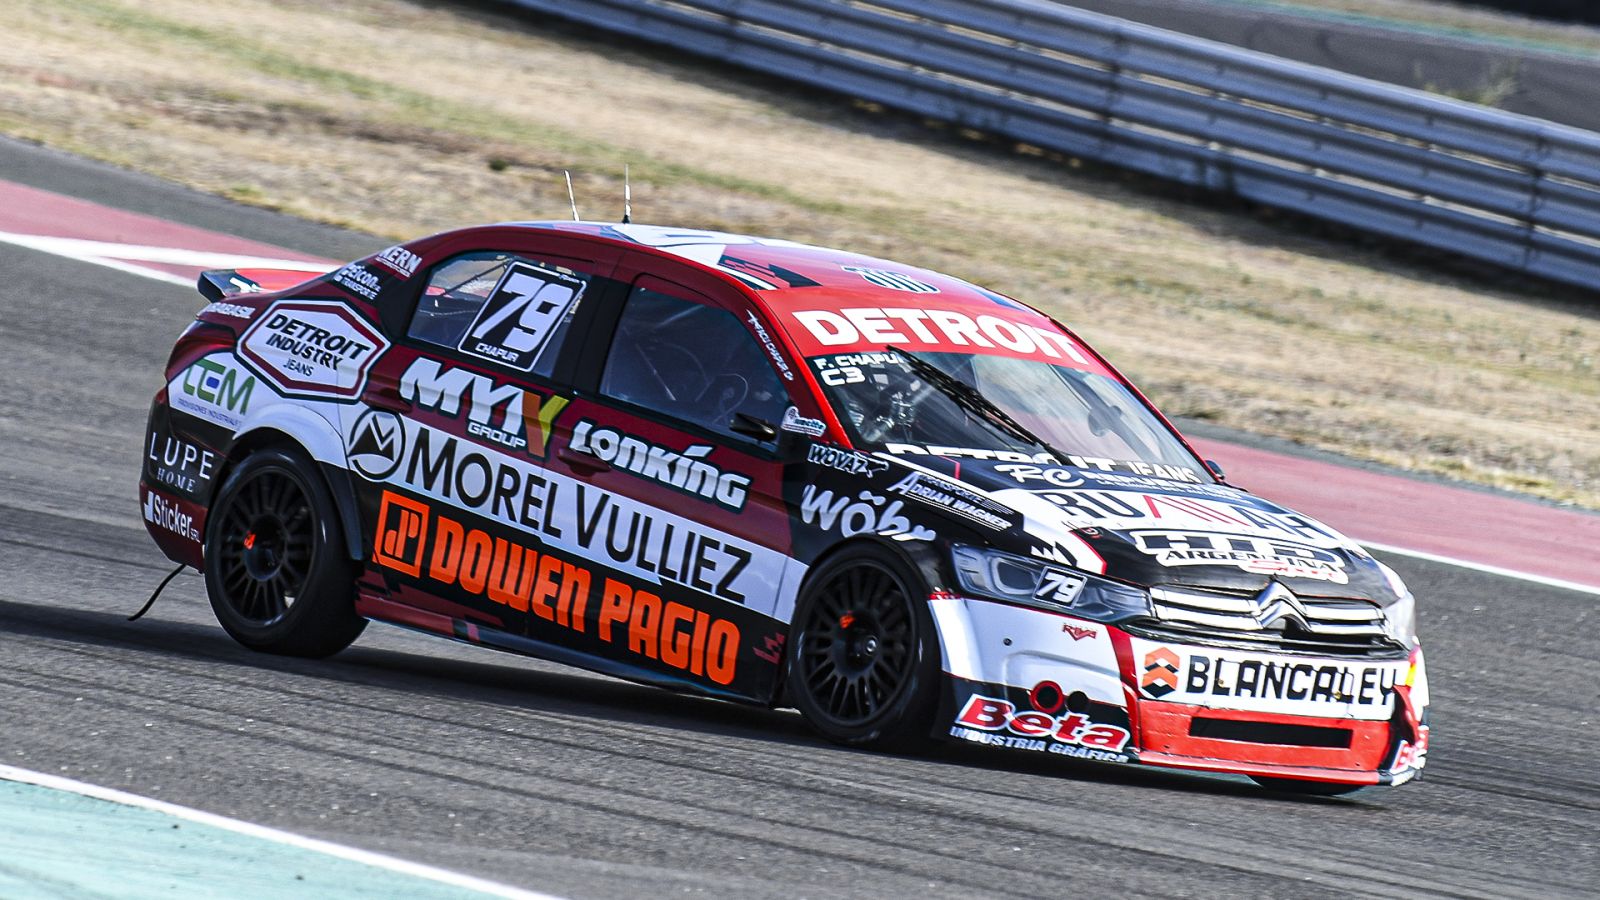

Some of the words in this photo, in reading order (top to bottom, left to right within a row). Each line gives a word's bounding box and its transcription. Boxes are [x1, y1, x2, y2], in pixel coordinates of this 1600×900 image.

[472, 272, 573, 352] 79
[266, 314, 370, 360] DETROIT
[266, 333, 343, 370] INDUSTRY
[475, 343, 519, 362] CHAPUR
[791, 308, 1089, 365] DETROIT
[283, 358, 314, 377] JEANS
[820, 367, 866, 386] C3
[467, 421, 527, 448] GROUP
[149, 432, 214, 480] LUPE
[157, 467, 196, 493] HOME
[886, 470, 954, 506] ADRIAN
[952, 499, 1013, 528] WAGNER
[405, 427, 562, 540] MOREL
[576, 484, 752, 604] VULLIEZ
[1165, 550, 1337, 573] ARGENTINA
[429, 515, 592, 633] DOWEN
[599, 577, 741, 686] PAGIO
[1036, 571, 1084, 603] 79
[1185, 655, 1396, 706] BLANCALEY
[950, 726, 1046, 752] INDUSTRIA
[956, 694, 1130, 752] Beta
